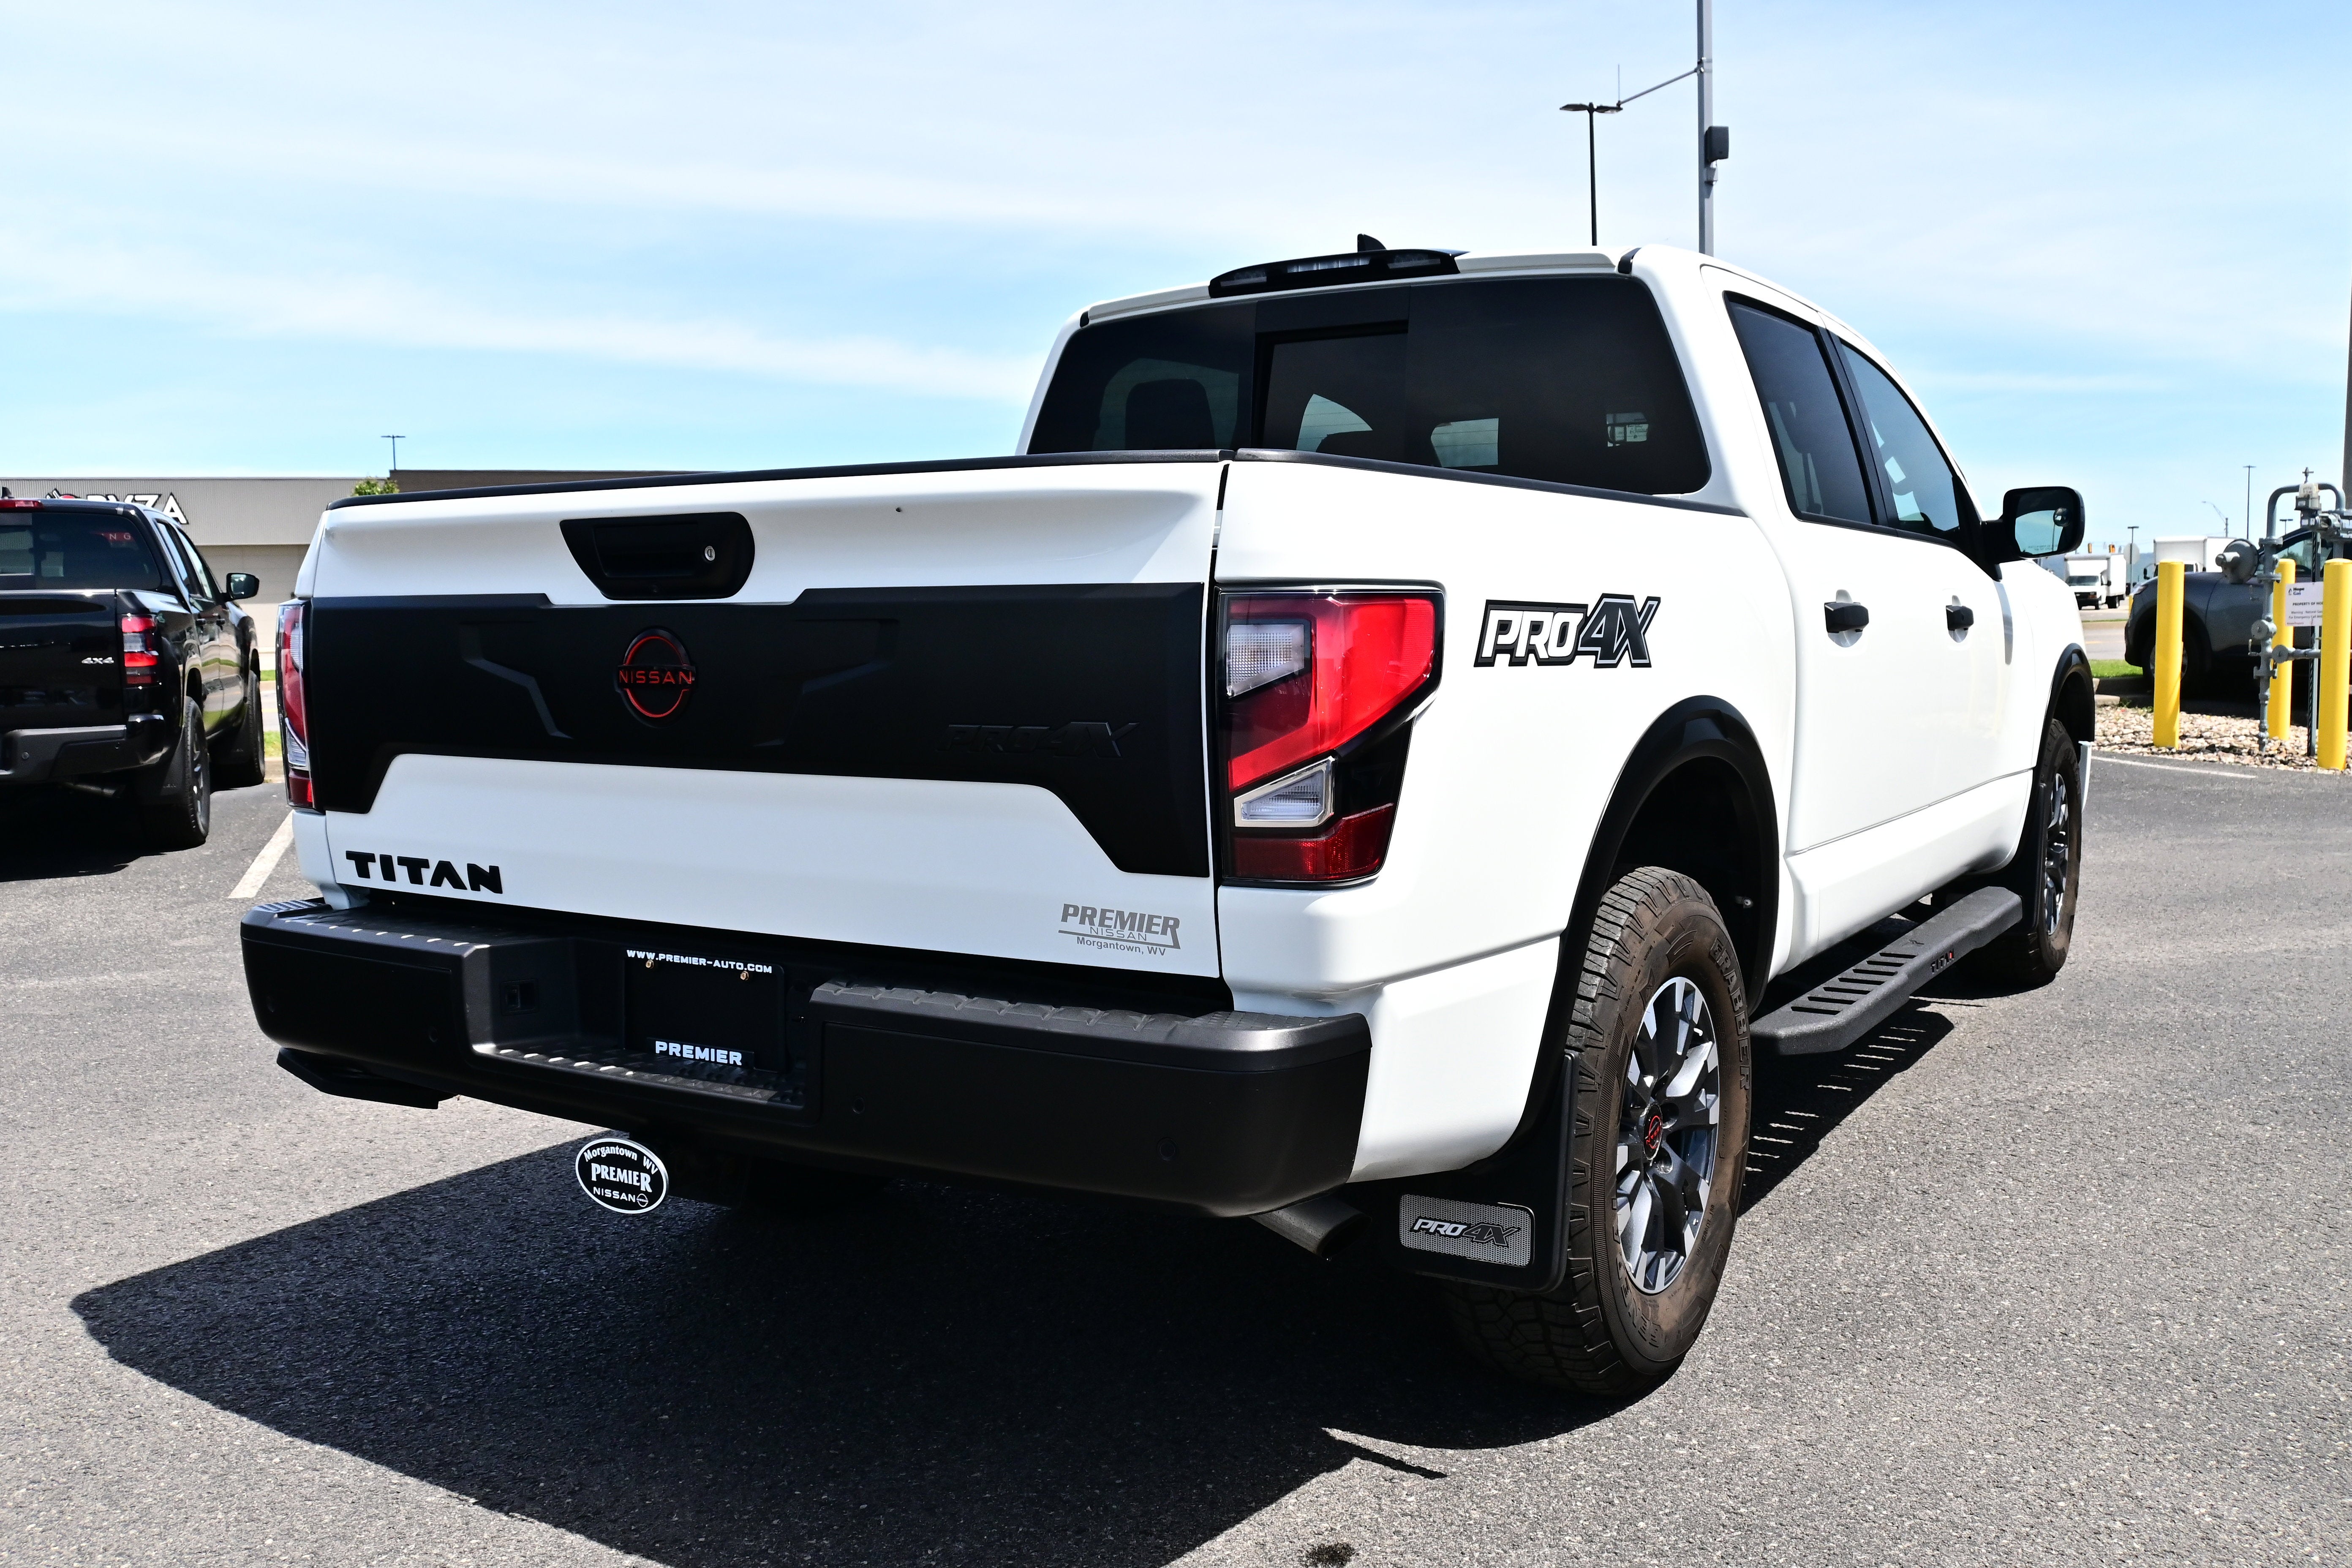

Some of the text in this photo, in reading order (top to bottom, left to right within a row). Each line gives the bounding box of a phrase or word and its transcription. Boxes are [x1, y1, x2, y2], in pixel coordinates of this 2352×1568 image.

[619, 670, 692, 684] NISSAN
[346, 850, 503, 894] TITAN
[1061, 903, 1181, 947] PREMIER
[1090, 926, 1147, 941] NISSAN
[1077, 936, 1166, 956] Morgantown, WV
[626, 950, 772, 973] WWW.PREMIER-AUTO.COM
[655, 1040, 742, 1066] PREMIER
[583, 1145, 659, 1174] Morgantown WV
[591, 1163, 652, 1192] PREMIER
[593, 1186, 635, 1202] NISSAN
